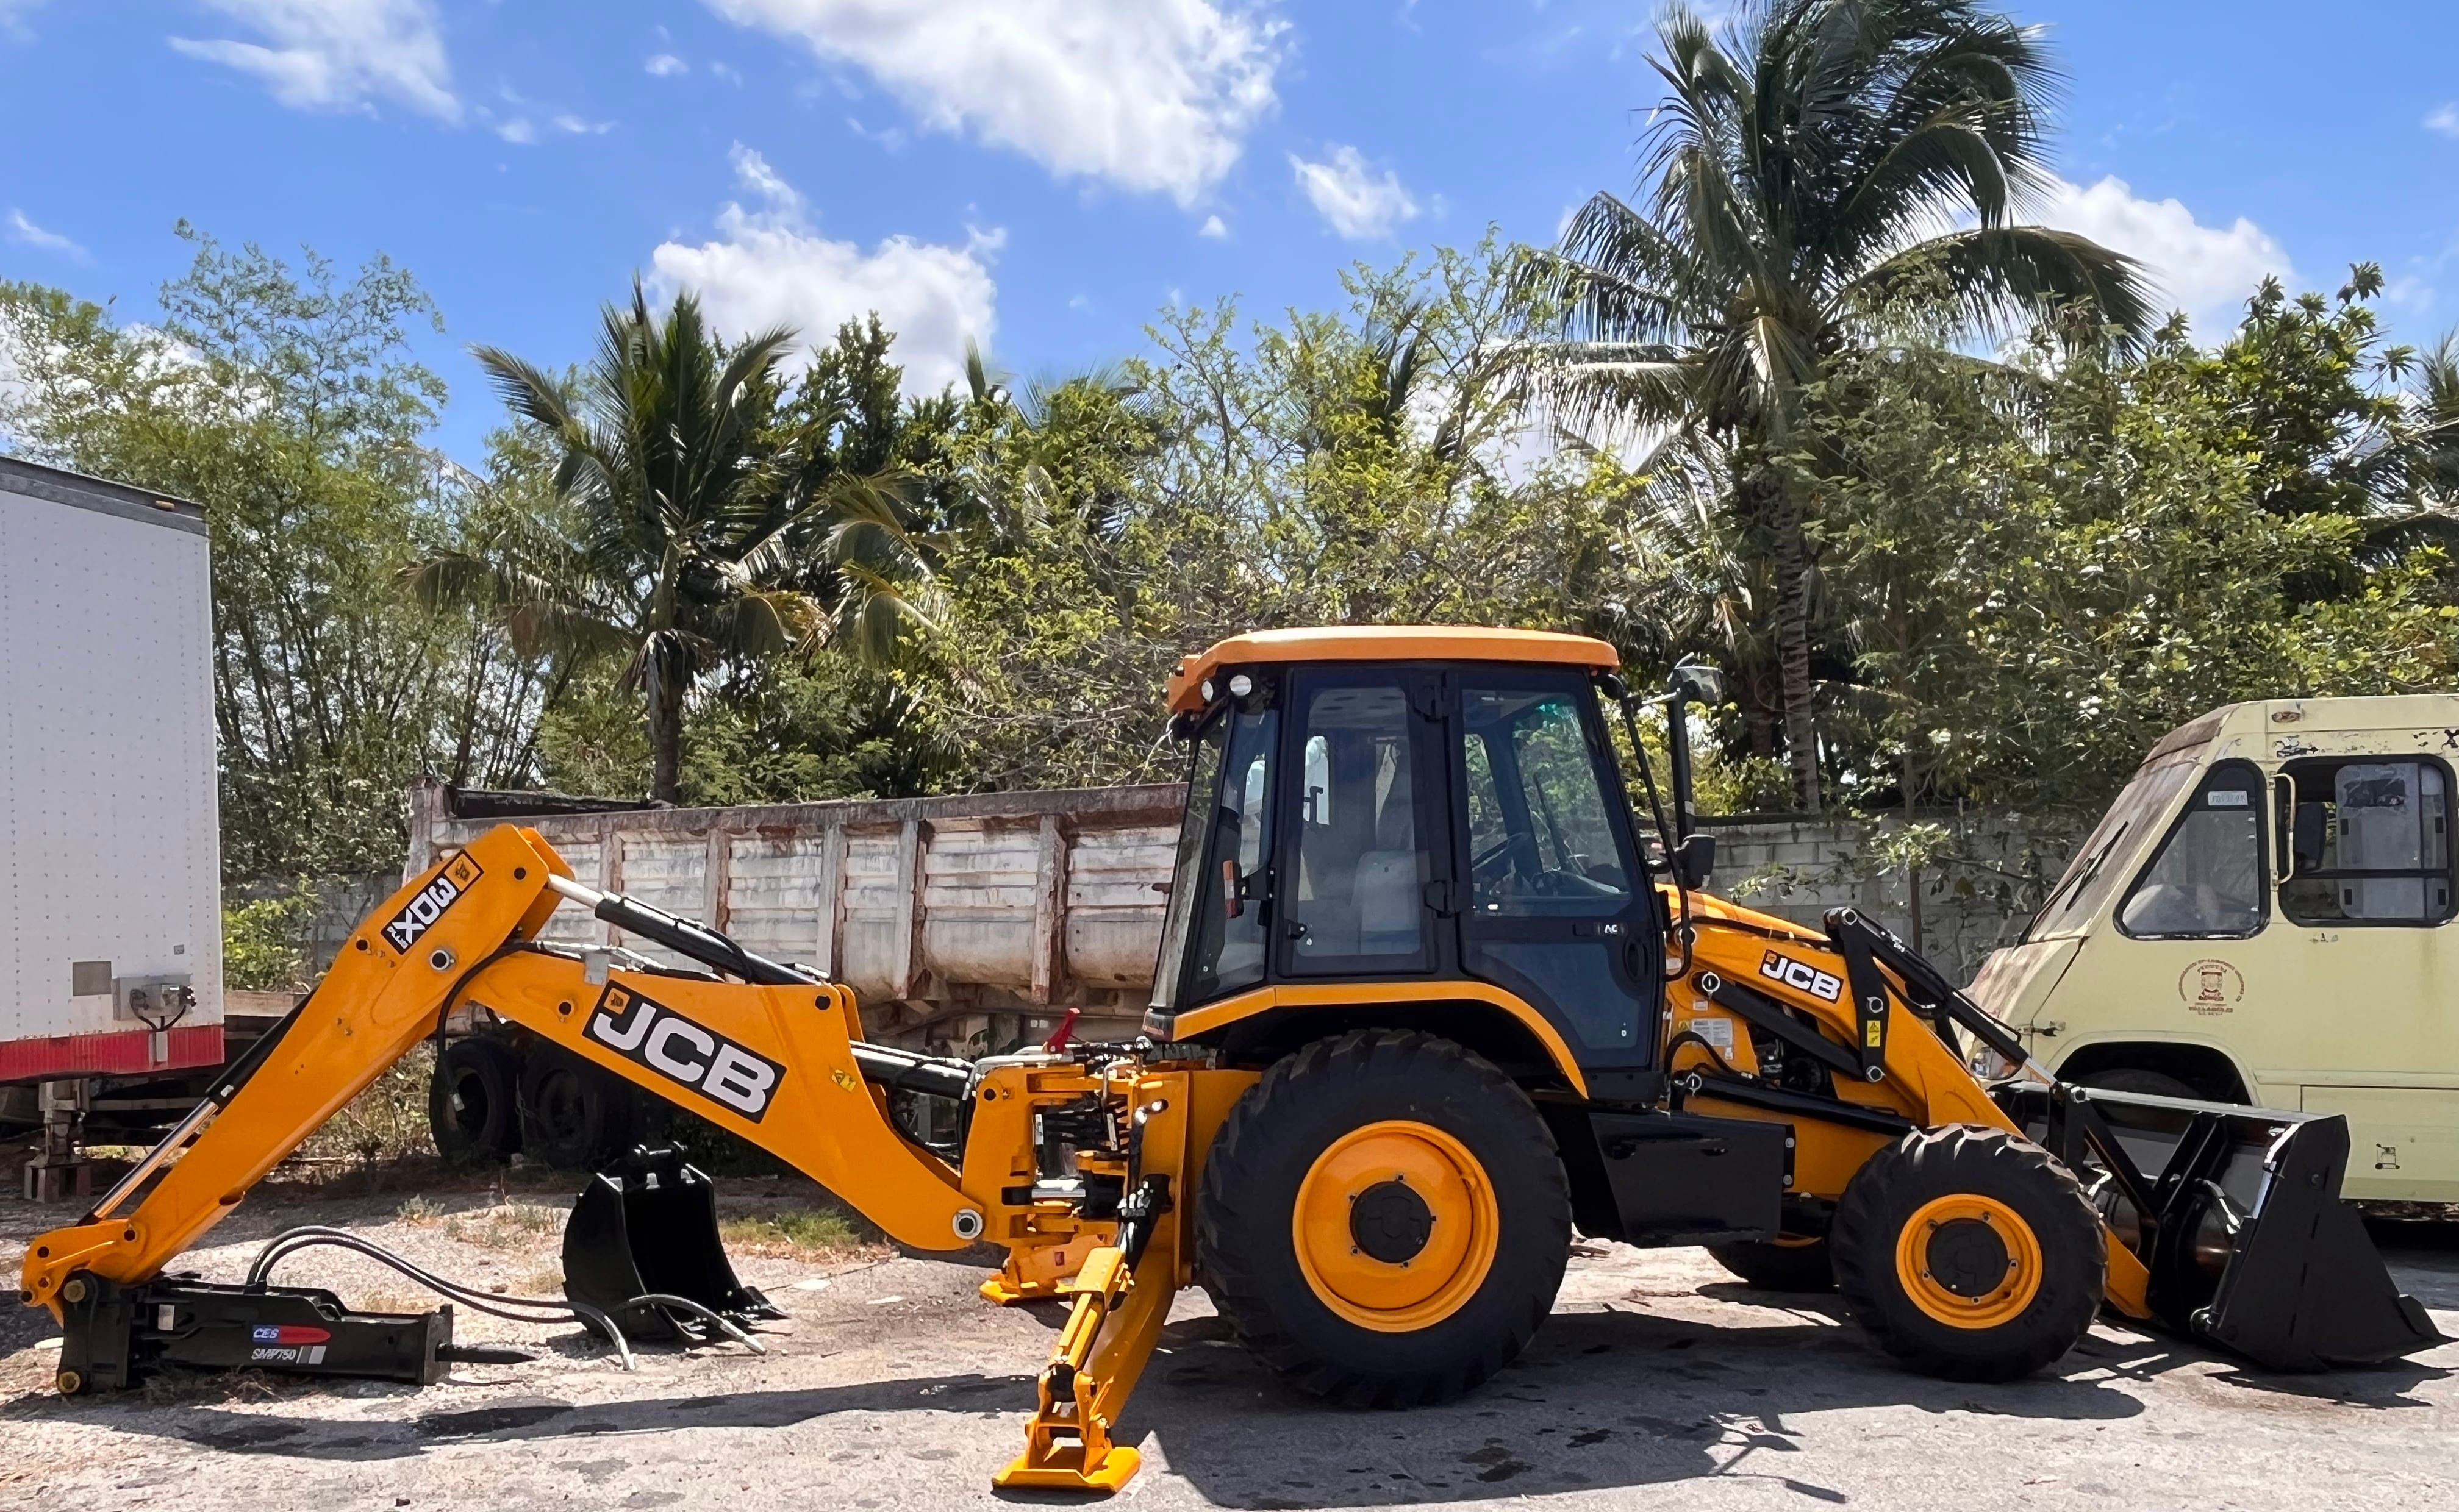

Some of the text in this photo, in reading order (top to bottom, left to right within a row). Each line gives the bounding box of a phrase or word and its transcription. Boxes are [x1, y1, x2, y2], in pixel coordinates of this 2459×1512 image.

[391, 877, 457, 945] 3DX
[1762, 957, 1841, 1000] JCB
[593, 1002, 775, 1113] JCB
[253, 1328, 279, 1339] CES
